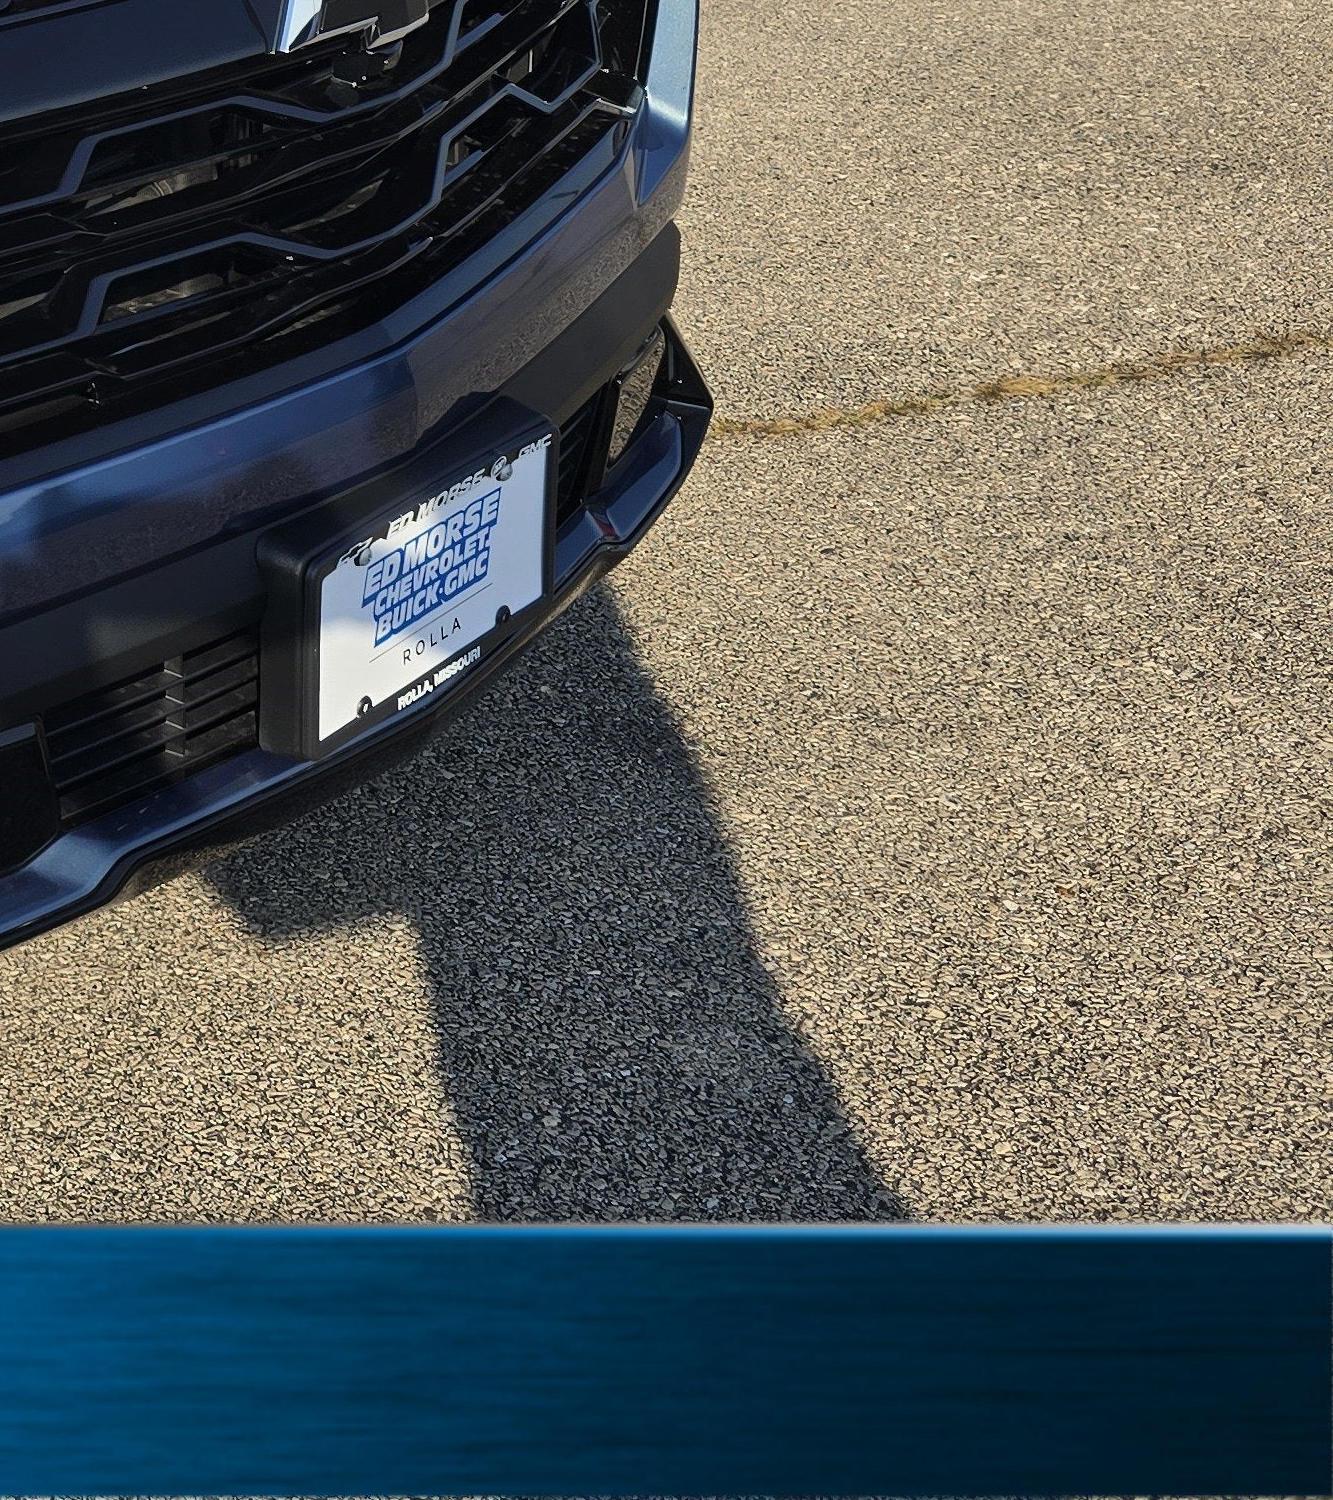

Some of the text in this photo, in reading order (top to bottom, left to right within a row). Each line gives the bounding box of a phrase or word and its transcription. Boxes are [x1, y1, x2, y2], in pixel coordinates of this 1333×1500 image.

[417, 468, 486, 522] MORSE
[362, 488, 501, 602] ED MORSE
[374, 528, 491, 617] CHEVROLET
[403, 617, 461, 665] ROLLA
[433, 645, 481, 687] MISSOURI
